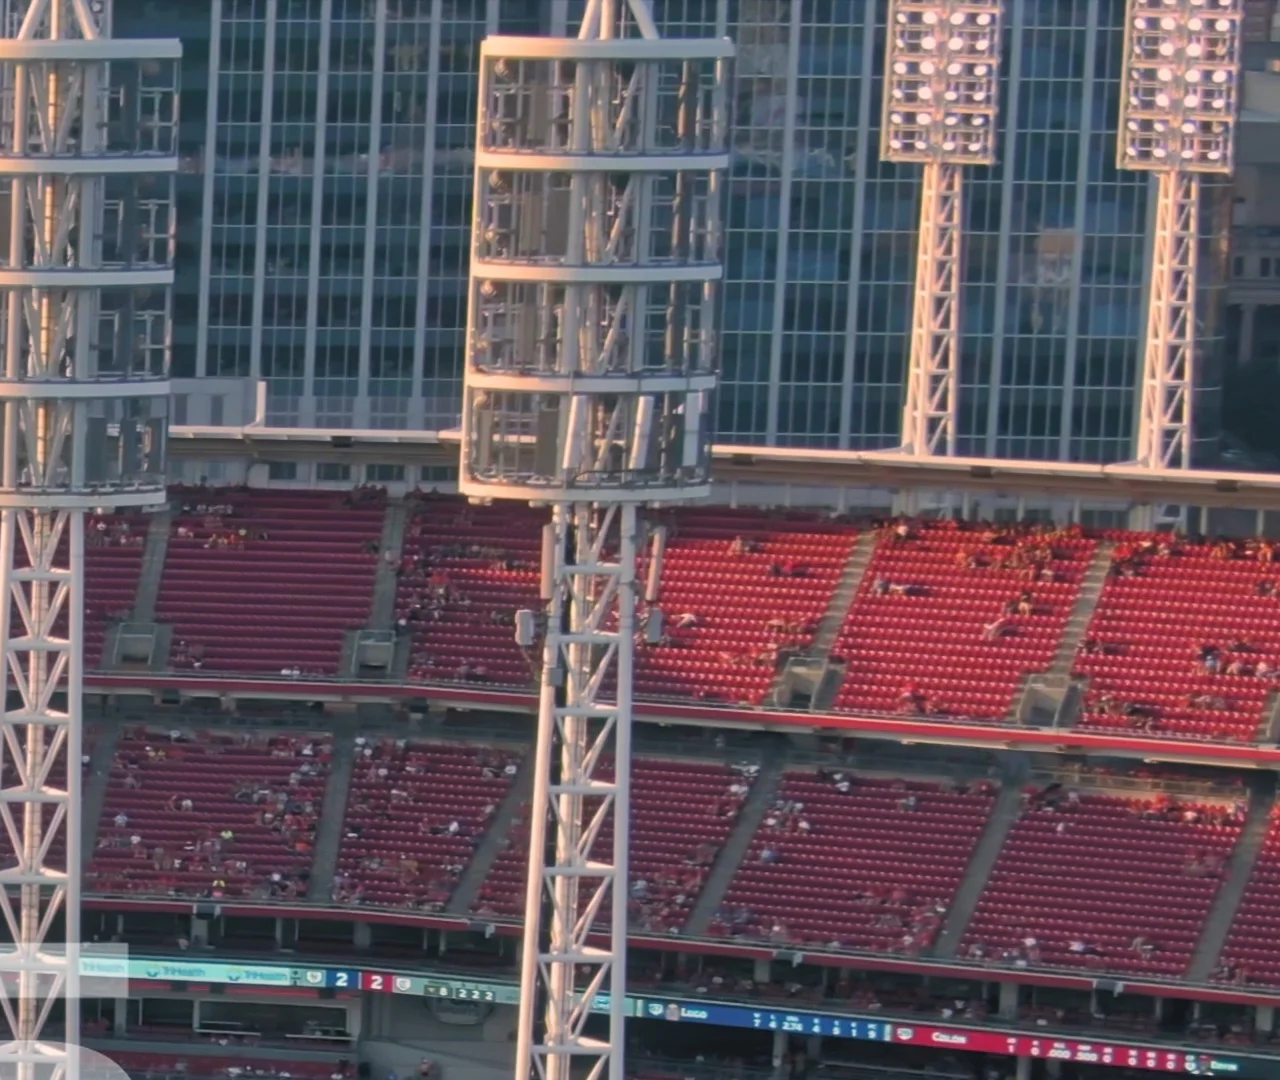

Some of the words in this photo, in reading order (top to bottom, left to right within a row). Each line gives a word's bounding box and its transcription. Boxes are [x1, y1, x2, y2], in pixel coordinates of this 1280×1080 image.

[335, 972, 349, 987] 2
[370, 975, 384, 990] 2
[459, 989, 467, 998] 2
[471, 990, 480, 999] 2
[484, 991, 494, 1000] 2
